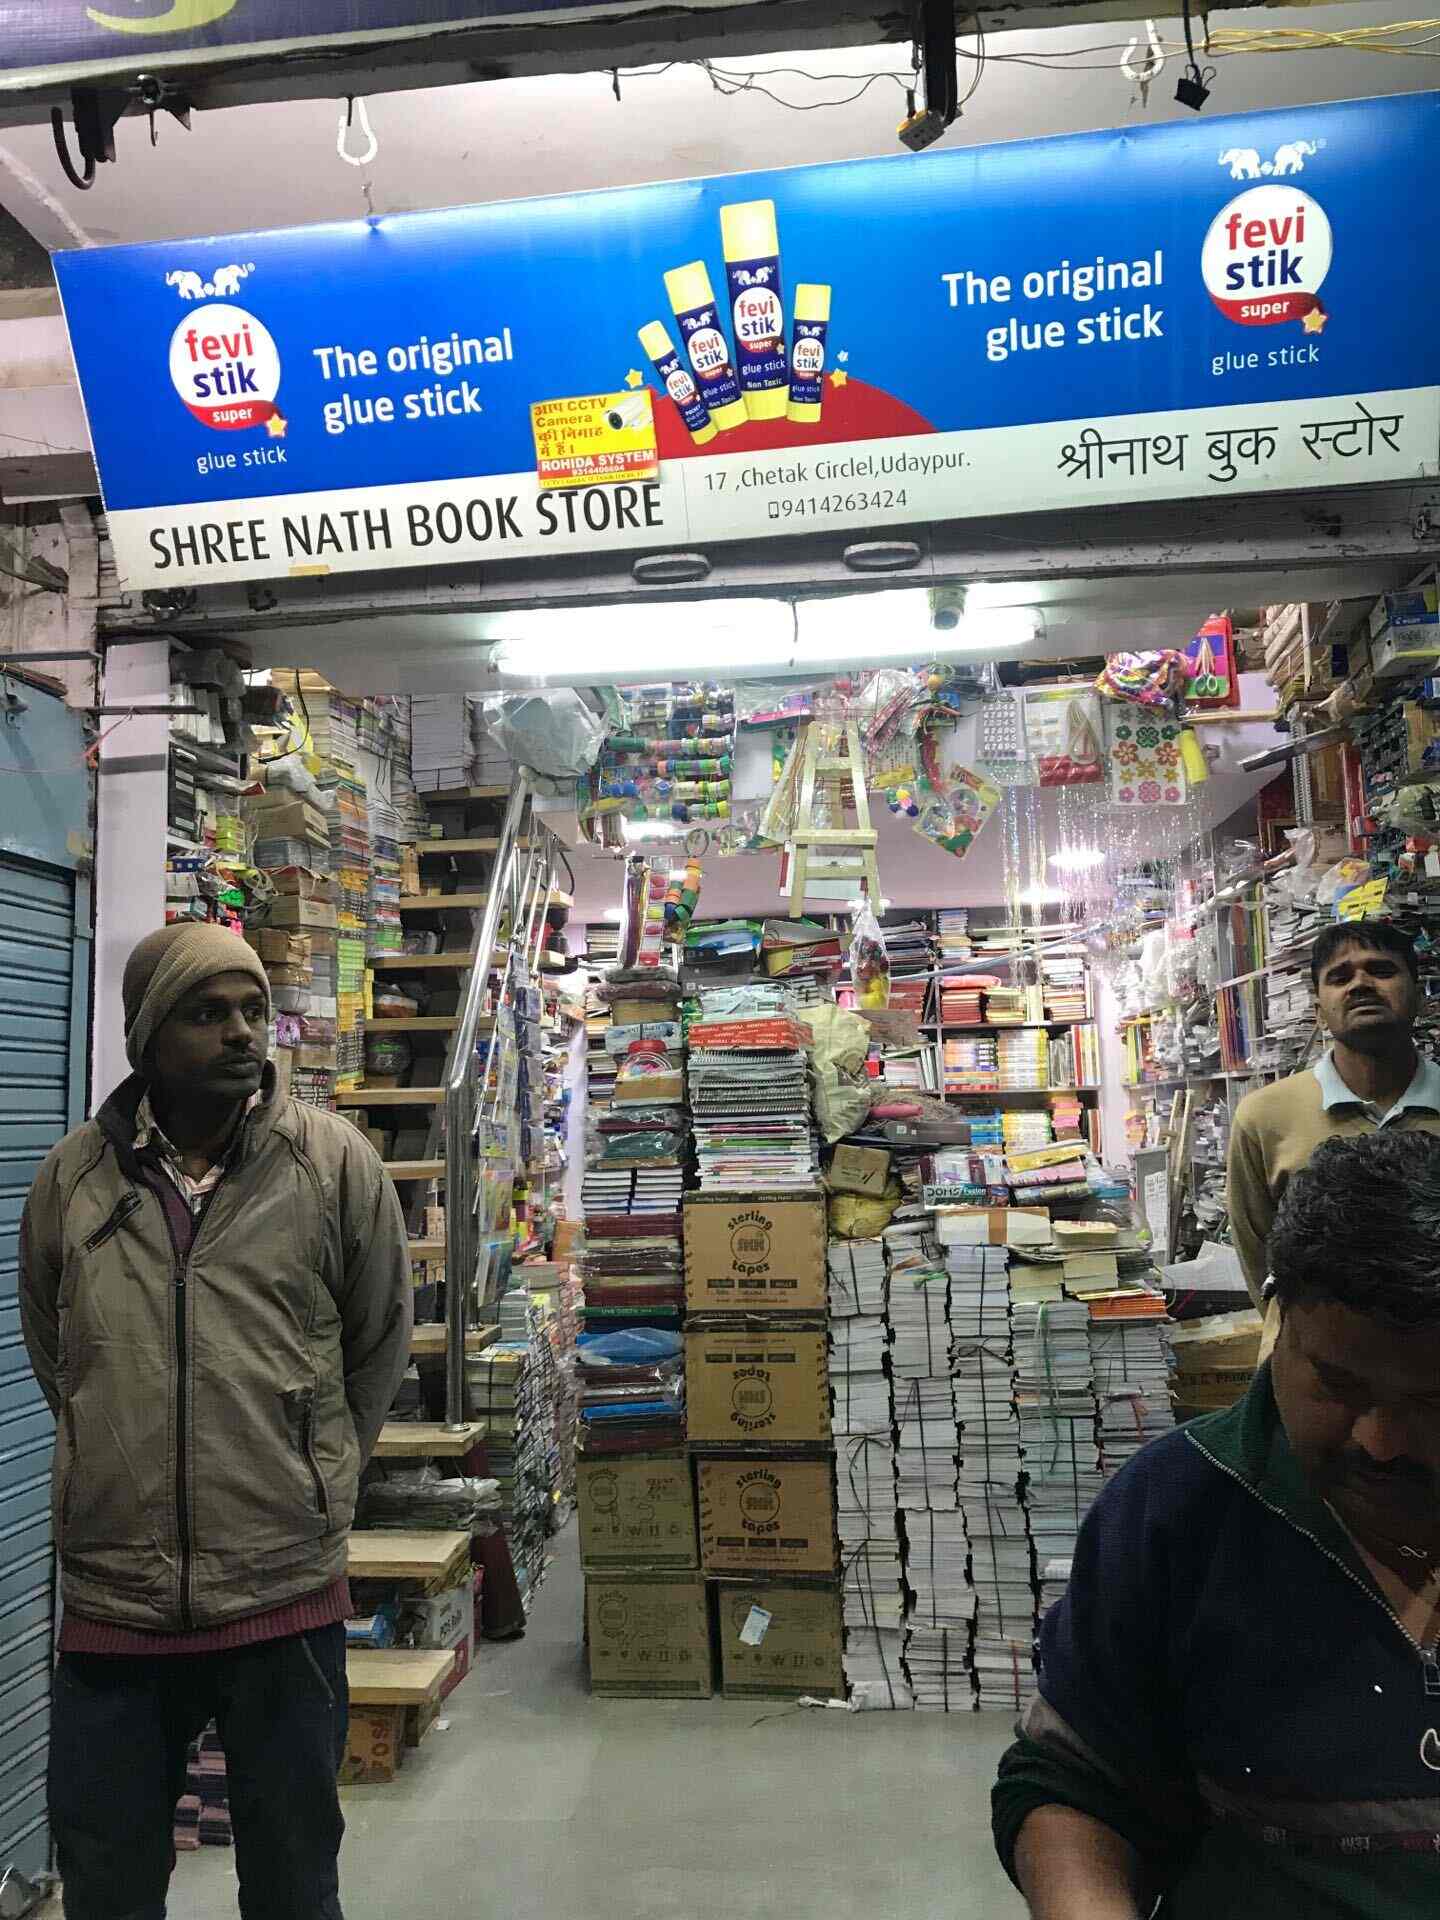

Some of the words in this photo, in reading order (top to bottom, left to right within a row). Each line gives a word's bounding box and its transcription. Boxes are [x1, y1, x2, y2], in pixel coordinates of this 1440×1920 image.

[1225, 206, 1305, 250] fevi
[941, 271, 1011, 307] The
[1023, 250, 1163, 302] original
[1226, 249, 1304, 291] stik
[738, 296, 775, 318] fevi
[1240, 301, 1290, 319] super
[741, 317, 776, 337] stik
[986, 318, 1066, 362] glue
[1077, 303, 1164, 345] stick
[184, 323, 254, 362] fevi
[313, 346, 378, 380] The
[387, 327, 513, 375] original
[691, 332, 720, 355] fevi
[798, 344, 820, 357] fevi
[696, 349, 724, 369] stik
[742, 363, 762, 376] glue
[764, 358, 786, 371] stick
[796, 357, 818, 369] stik
[1212, 352, 1259, 376] glue
[1267, 343, 1320, 367] stick
[192, 361, 260, 399] stik
[212, 407, 253, 424] super
[323, 393, 395, 434] glue
[403, 381, 483, 420] stick
[534, 402, 563, 416] आप
[567, 397, 608, 412] CCTV
[535, 414, 593, 428] Camera
[1057, 427, 1189, 480] श्रीनाथ
[1205, 426, 1279, 482] बुक
[1299, 401, 1405, 461] स्टोर
[196, 453, 237, 474] glue
[242, 446, 288, 467] stick
[541, 455, 595, 472] ROHIDA
[598, 450, 655, 468] SYSTEM
[704, 472, 728, 491] 17
[782, 489, 907, 517] 9414263424
[149, 518, 271, 570] SHREE
[282, 508, 392, 557] NATH
[406, 495, 523, 547] BOOK
[536, 483, 665, 537] STORE
[728, 1210, 773, 1231] sterling
[732, 1260, 771, 1277] tapes
[736, 1469, 781, 1490] sterling
[742, 1518, 781, 1535] tapes
